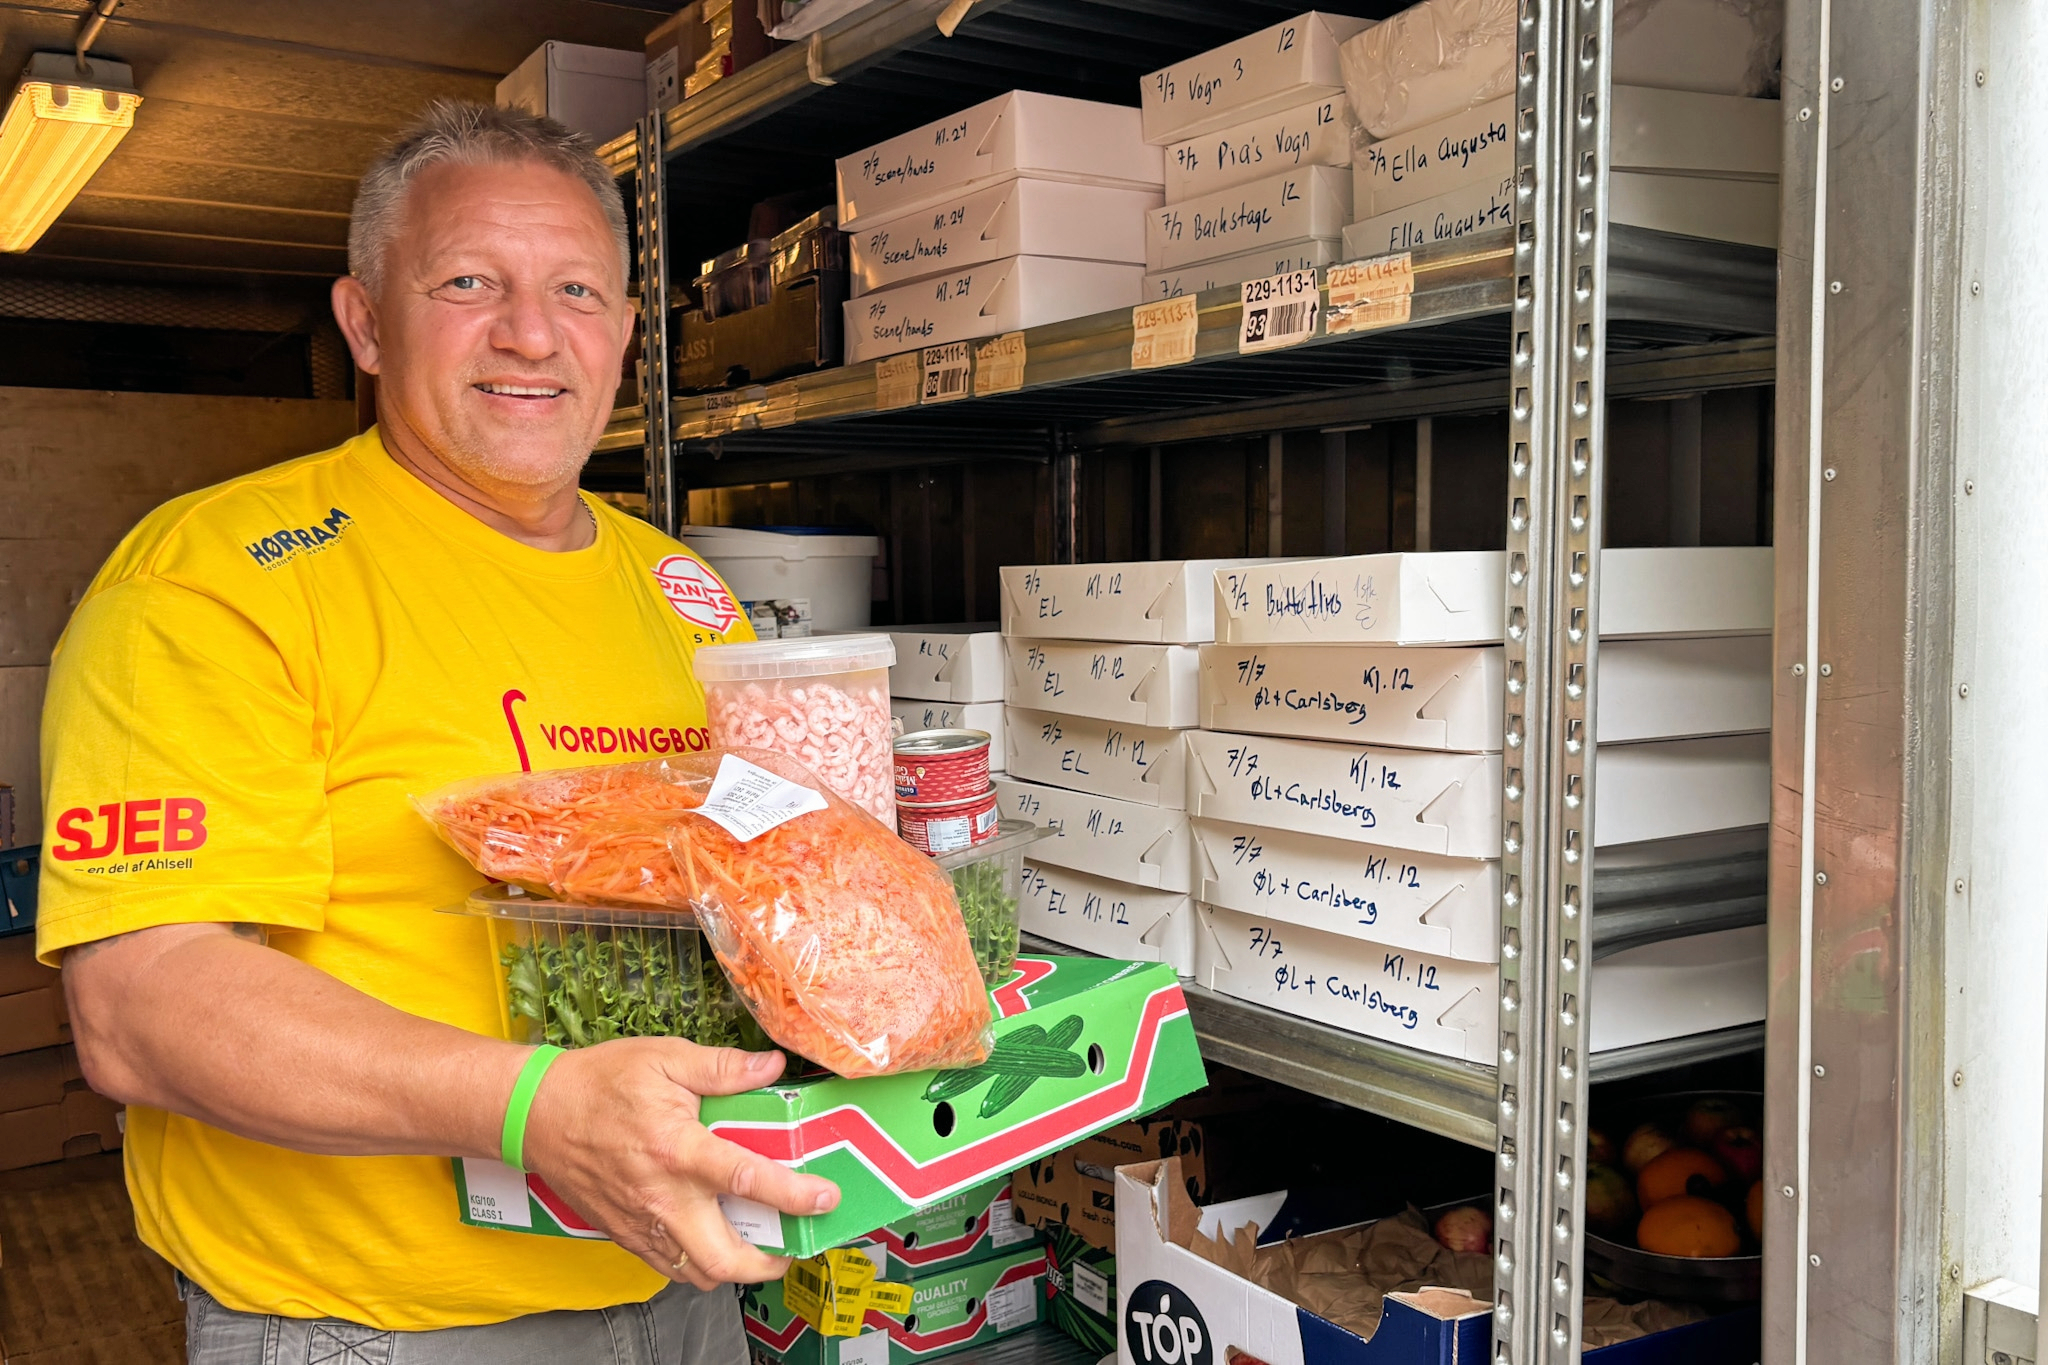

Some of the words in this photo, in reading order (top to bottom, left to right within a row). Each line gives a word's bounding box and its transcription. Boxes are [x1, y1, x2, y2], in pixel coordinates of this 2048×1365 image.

[1278, 27, 1295, 53] 12
[1156, 72, 1175, 103] 7/7
[1189, 73, 1222, 105] Vogn
[1233, 58, 1243, 81] 3
[1317, 104, 1334, 126] 12
[951, 121, 967, 142] 24
[1218, 136, 1263, 170] Pia's
[1276, 127, 1310, 163] Vogn
[1392, 145, 1428, 182] Ella
[1437, 122, 1506, 168] Augusta
[1281, 180, 1301, 207] 12
[950, 206, 965, 224] 24
[1389, 221, 1424, 251] Ella
[956, 275, 971, 297] 24
[1246, 269, 1317, 303] 229-113-1
[1247, 313, 1268, 338] 93
[673, 338, 707, 364] CLASS
[925, 344, 969, 367] 229-111-1
[245, 507, 351, 567] HØRRAM
[1025, 568, 1040, 596] 7/7
[1109, 572, 1122, 595] 12
[1227, 573, 1249, 612] 7/7
[1039, 595, 1063, 619] EL
[1027, 644, 1045, 672] 7/7
[1112, 656, 1125, 680] 12
[1237, 655, 1266, 686] 7/7
[1391, 668, 1414, 690] 12
[1043, 670, 1065, 697] EL
[1041, 720, 1063, 745] 7/7
[1131, 740, 1147, 766] 12
[1061, 750, 1090, 775] EL
[1227, 746, 1258, 777] 7/7
[1381, 766, 1401, 790] 12
[1018, 794, 1040, 816] 7/7
[1108, 818, 1124, 836] 12
[1284, 784, 1377, 828] Carlsberg
[52, 797, 208, 862] SJEB
[87, 865, 105, 875] en
[108, 862, 129, 874] del
[132, 860, 145, 872] af
[146, 857, 193, 871] Ahlsell
[1232, 836, 1263, 866] 7/7
[1398, 864, 1421, 888] 12
[1021, 867, 1047, 897] 7/7
[1047, 889, 1067, 915] EL
[1110, 901, 1129, 925] 12
[1297, 881, 1378, 925] Carlsberg
[1249, 927, 1284, 960] 7/7
[1417, 962, 1440, 991] 12
[1326, 976, 1418, 1029] Carlsberg
[470, 1194, 496, 1207] KG/100
[471, 1207, 497, 1220] CLASS
[915, 1194, 968, 1218] QUALITY
[913, 1278, 969, 1304] QUALITY
[937, 1294, 968, 1311] SELECTED
[927, 1304, 960, 1319] GROWERS
[1132, 1311, 1202, 1365] TOP
